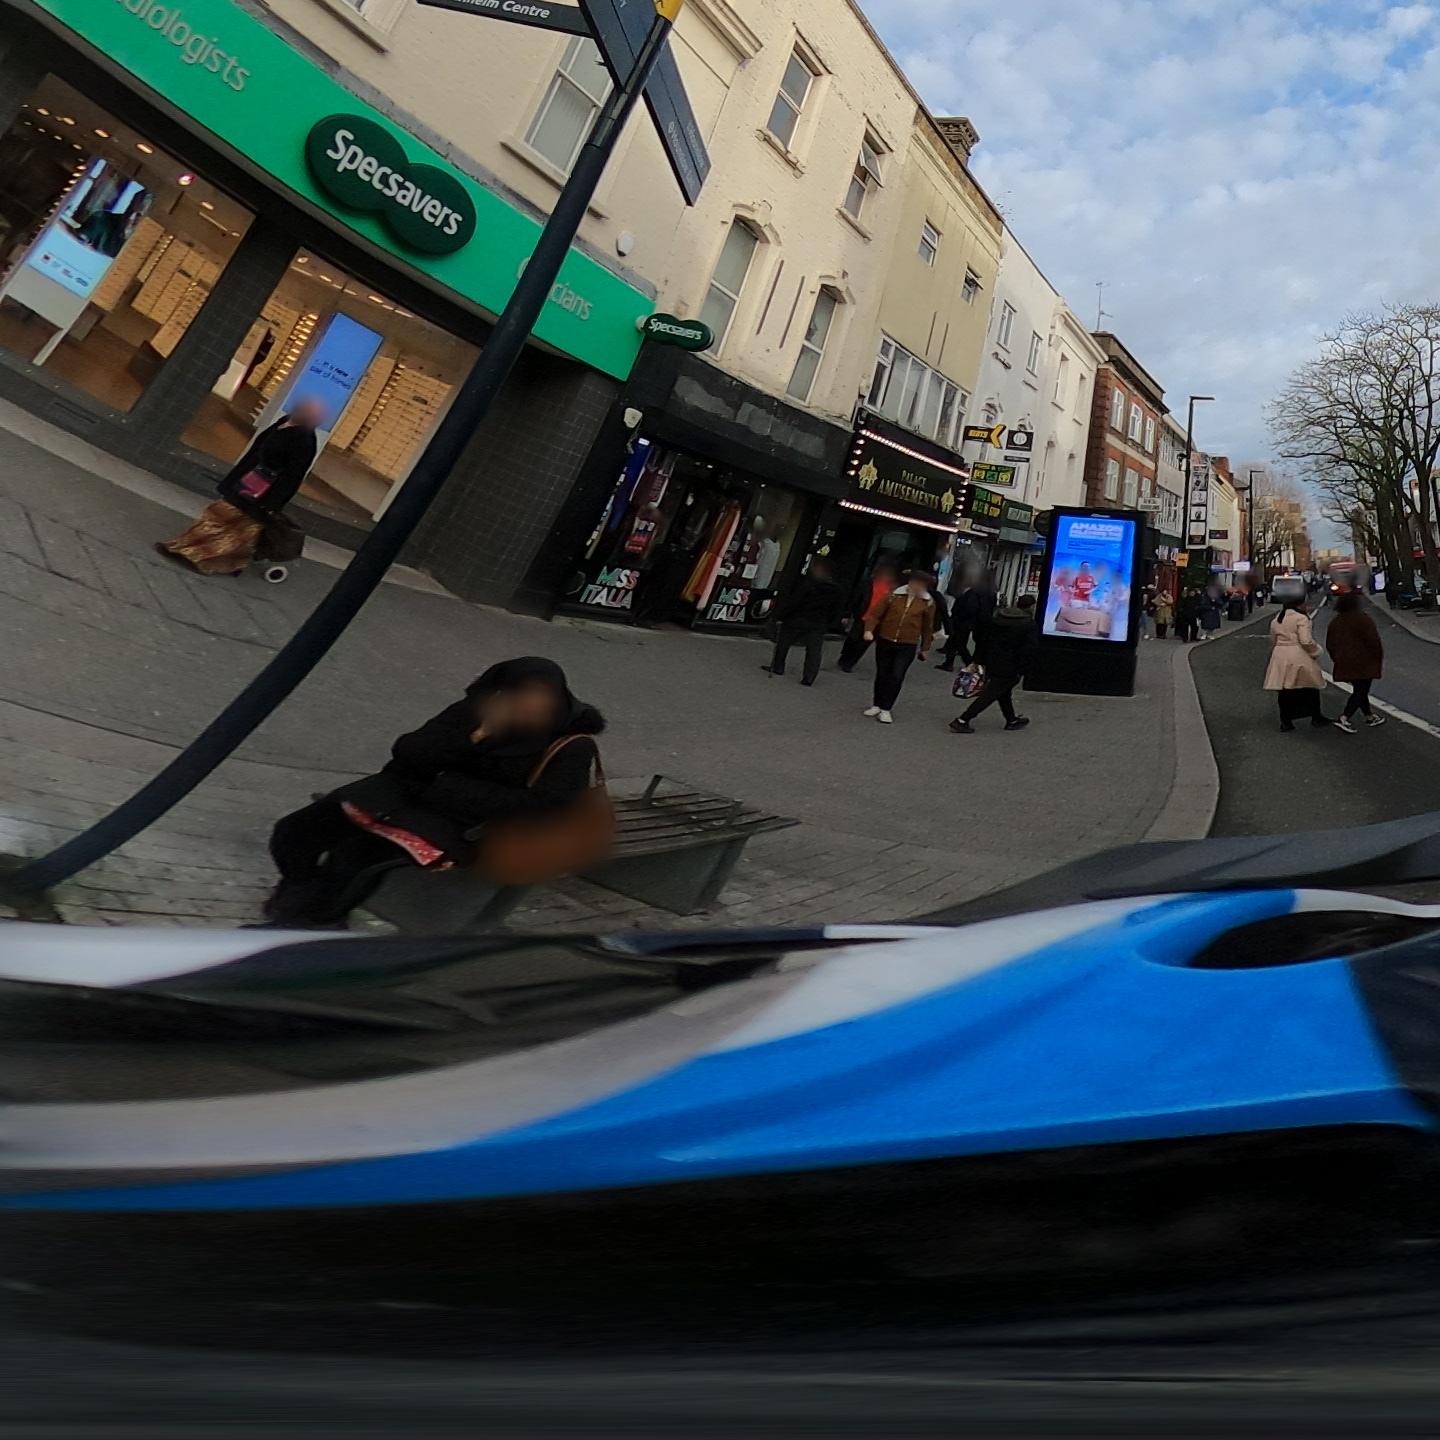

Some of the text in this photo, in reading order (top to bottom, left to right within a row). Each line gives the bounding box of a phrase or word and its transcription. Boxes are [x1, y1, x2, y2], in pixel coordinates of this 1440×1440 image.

[502, 0, 550, 19] Centre
[326, 128, 463, 235] Specsavers
[648, 318, 702, 340] Specsavers
[901, 469, 927, 488] PALACE
[877, 478, 940, 510] AMUSEMENTS
[595, 565, 640, 589] MISS
[579, 583, 634, 609] ITALIA
[718, 586, 751, 606] MISS
[706, 602, 747, 622] ITALIA
